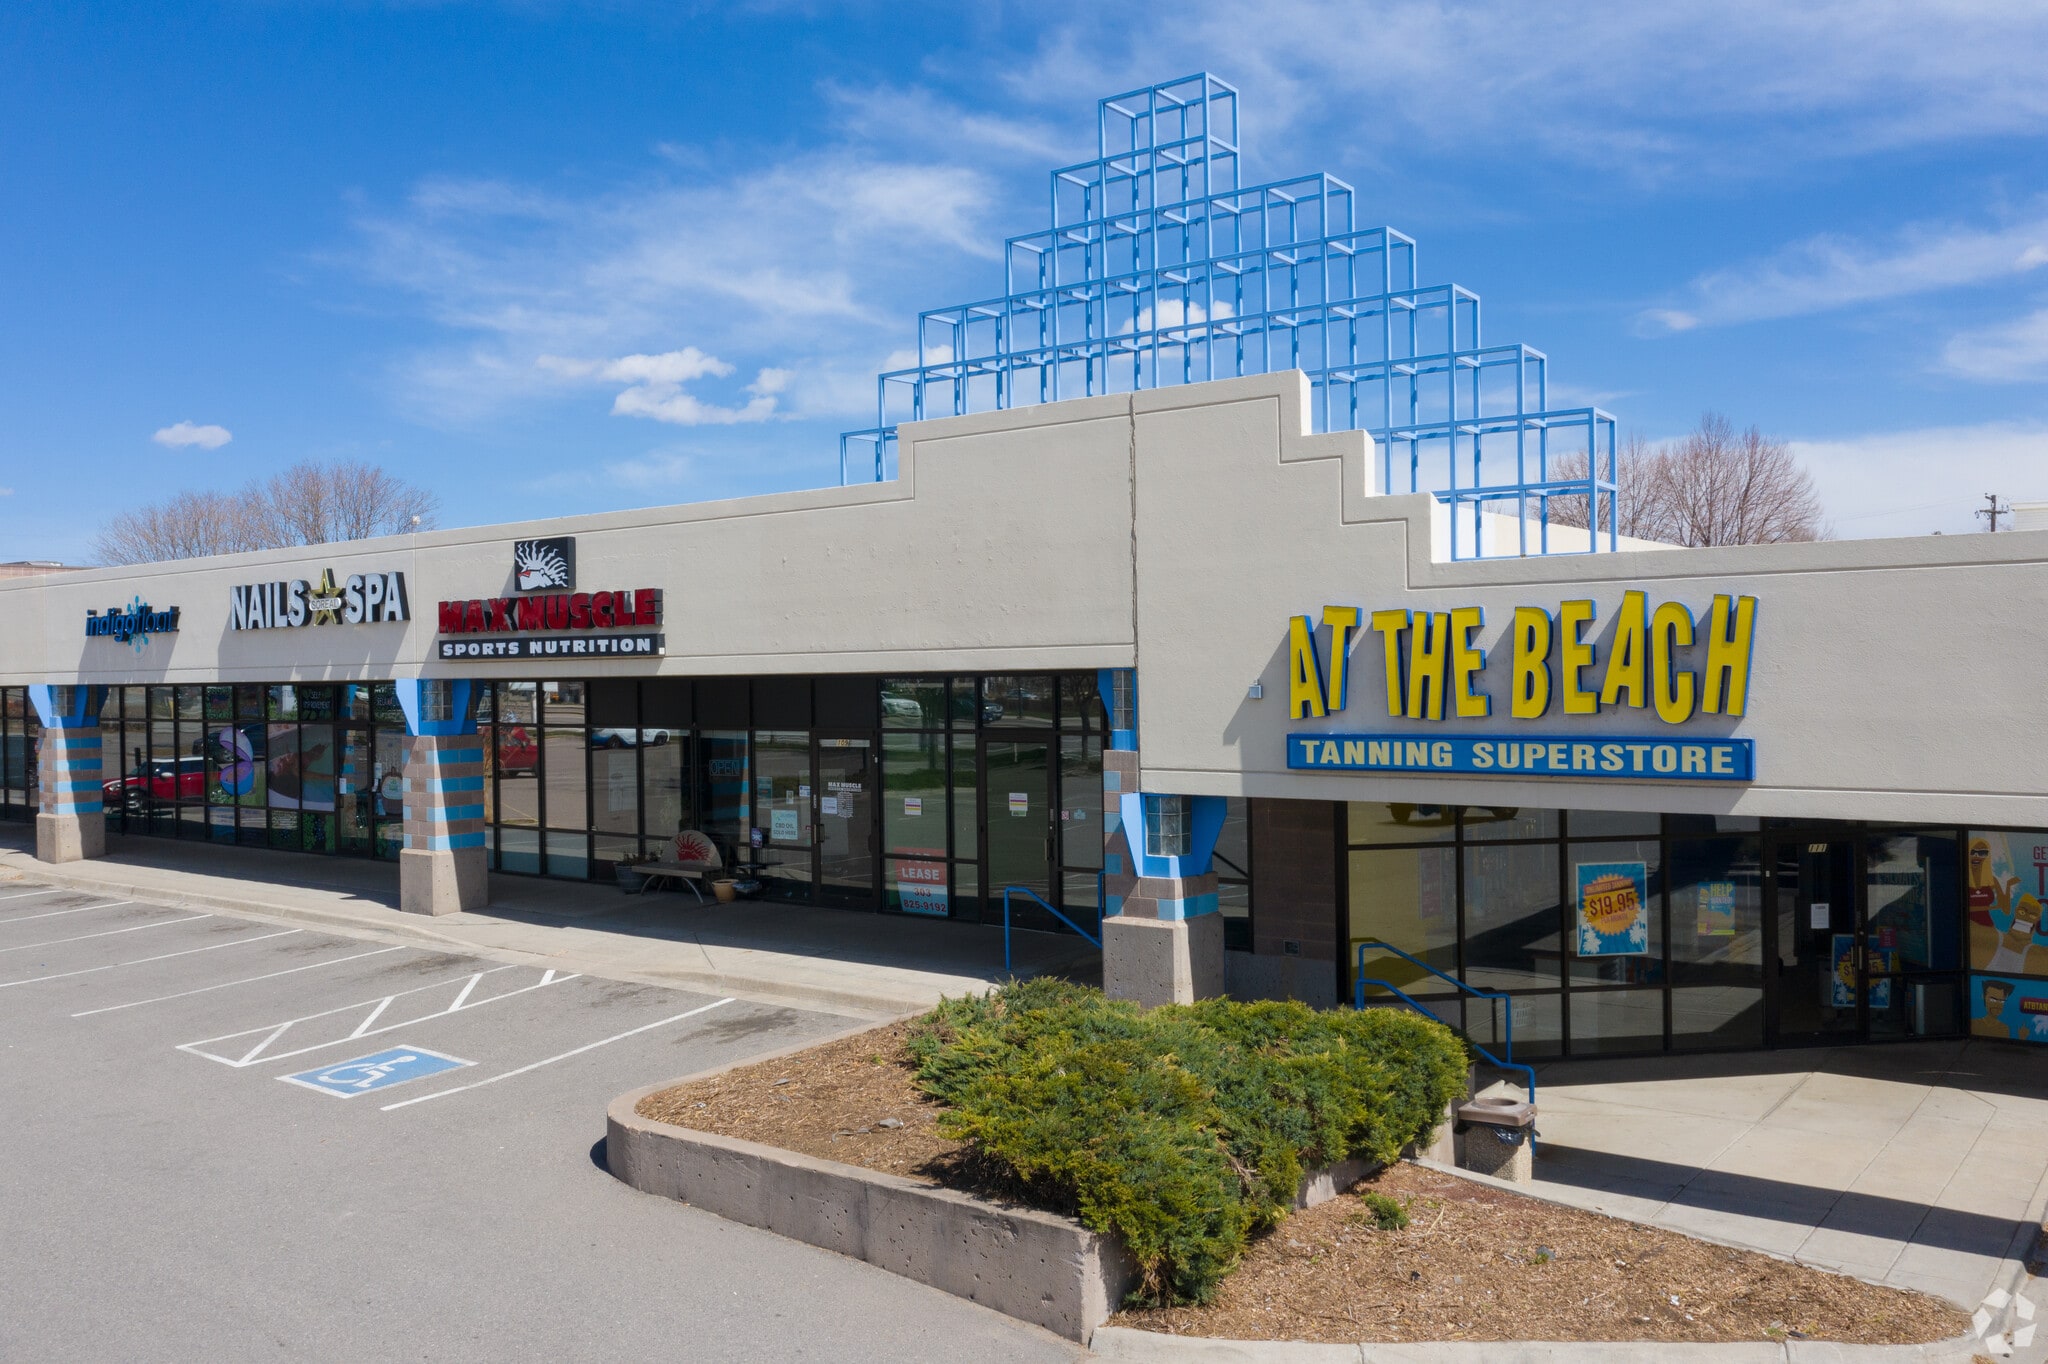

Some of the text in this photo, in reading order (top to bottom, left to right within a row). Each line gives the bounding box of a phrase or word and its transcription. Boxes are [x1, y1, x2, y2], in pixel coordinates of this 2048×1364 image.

[230, 571, 411, 631] NAILS SPA
[438, 588, 663, 634] MAX MUSCLE
[442, 638, 651, 657] SPORTS NUTRITION
[1289, 589, 1758, 724] AT THE BEACH
[1300, 740, 1735, 775] TANNING SUPERSTORE
[711, 761, 739, 774] OPEN
[2033, 846, 2048, 860] GE
[902, 867, 940, 881] LEASE
[914, 887, 932, 897] 303
[1710, 883, 1733, 896] HELP
[903, 899, 947, 913] 825-9192
[1589, 891, 1635, 917] $19.95
